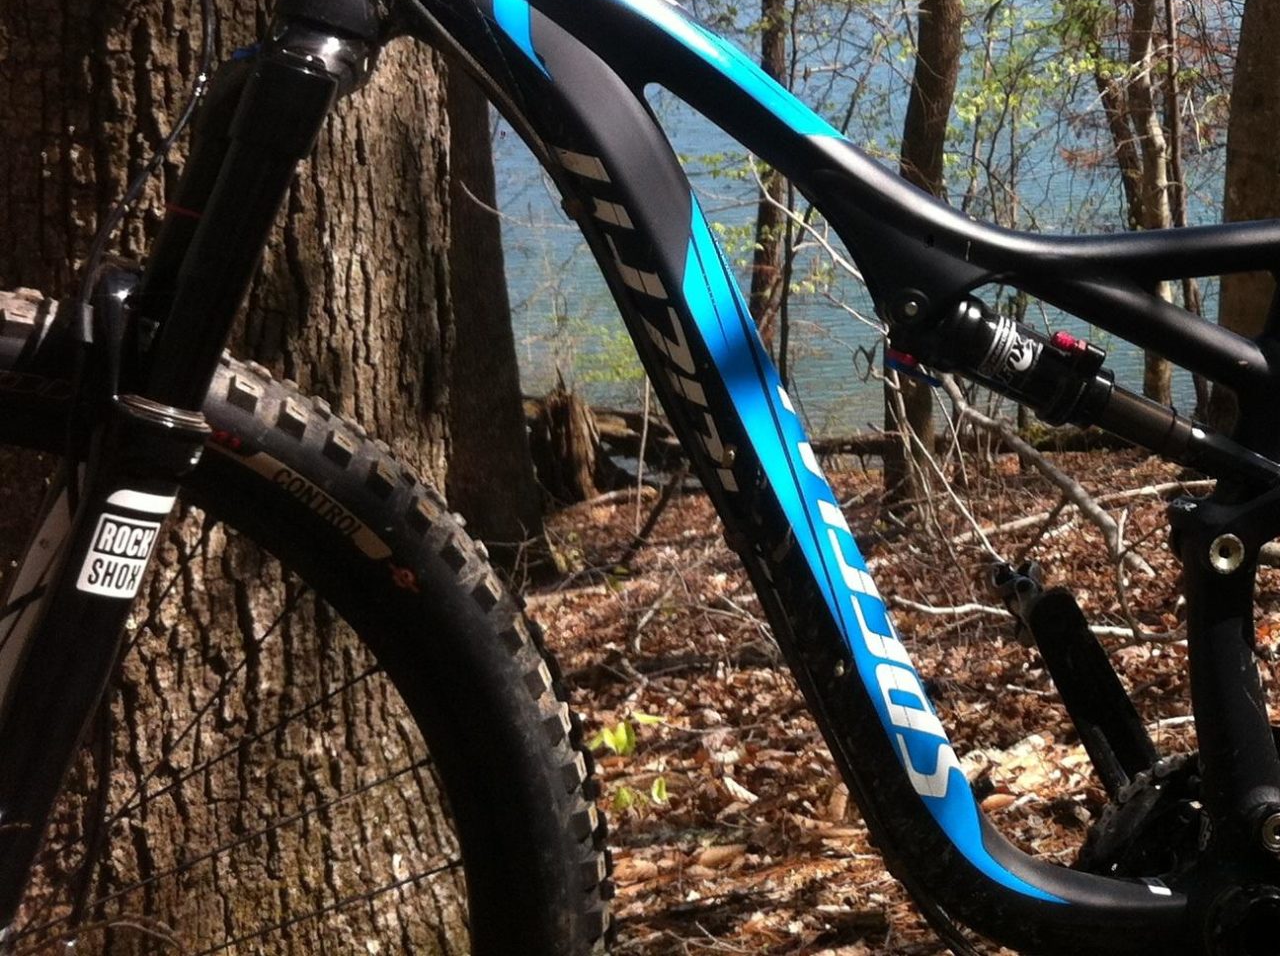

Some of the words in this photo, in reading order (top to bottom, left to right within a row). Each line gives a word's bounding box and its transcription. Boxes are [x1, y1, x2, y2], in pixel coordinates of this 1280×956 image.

[272, 467, 362, 537] CONTROL
[97, 521, 155, 558] ROCK
[87, 558, 142, 591] SHOX
